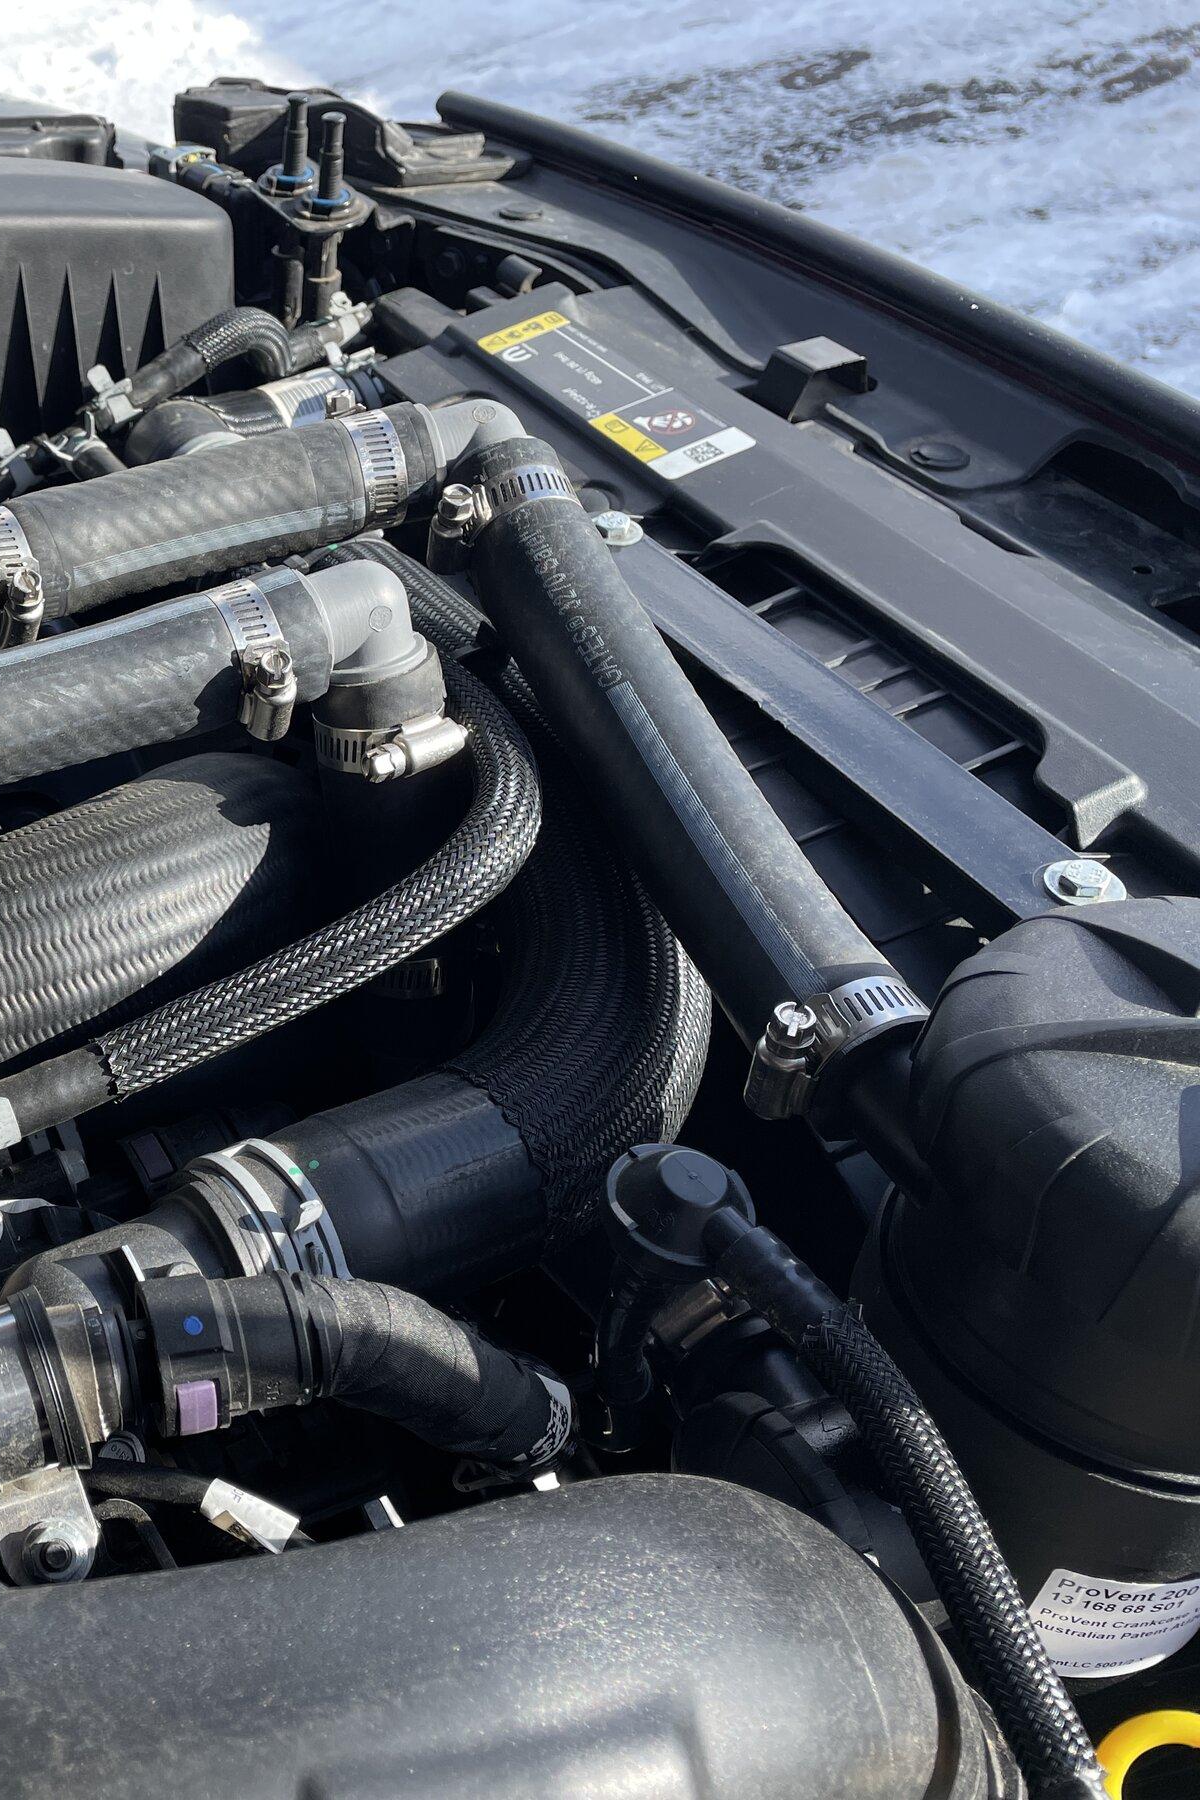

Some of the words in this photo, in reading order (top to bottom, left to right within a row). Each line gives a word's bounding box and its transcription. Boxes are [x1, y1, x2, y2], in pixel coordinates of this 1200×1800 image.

[1057, 1578, 1157, 1602] ProVent
[1161, 1585, 1200, 1601] 200
[1051, 1592, 1075, 1605] 13
[1081, 1600, 1117, 1613] 168
[1122, 1605, 1146, 1614] 68
[1150, 1600, 1185, 1613] S01
[1039, 1607, 1107, 1628] ProVent
[1112, 1611, 1190, 1629] Crankcase
[1034, 1619, 1116, 1640] Australian
[1119, 1627, 1168, 1640] Patent
